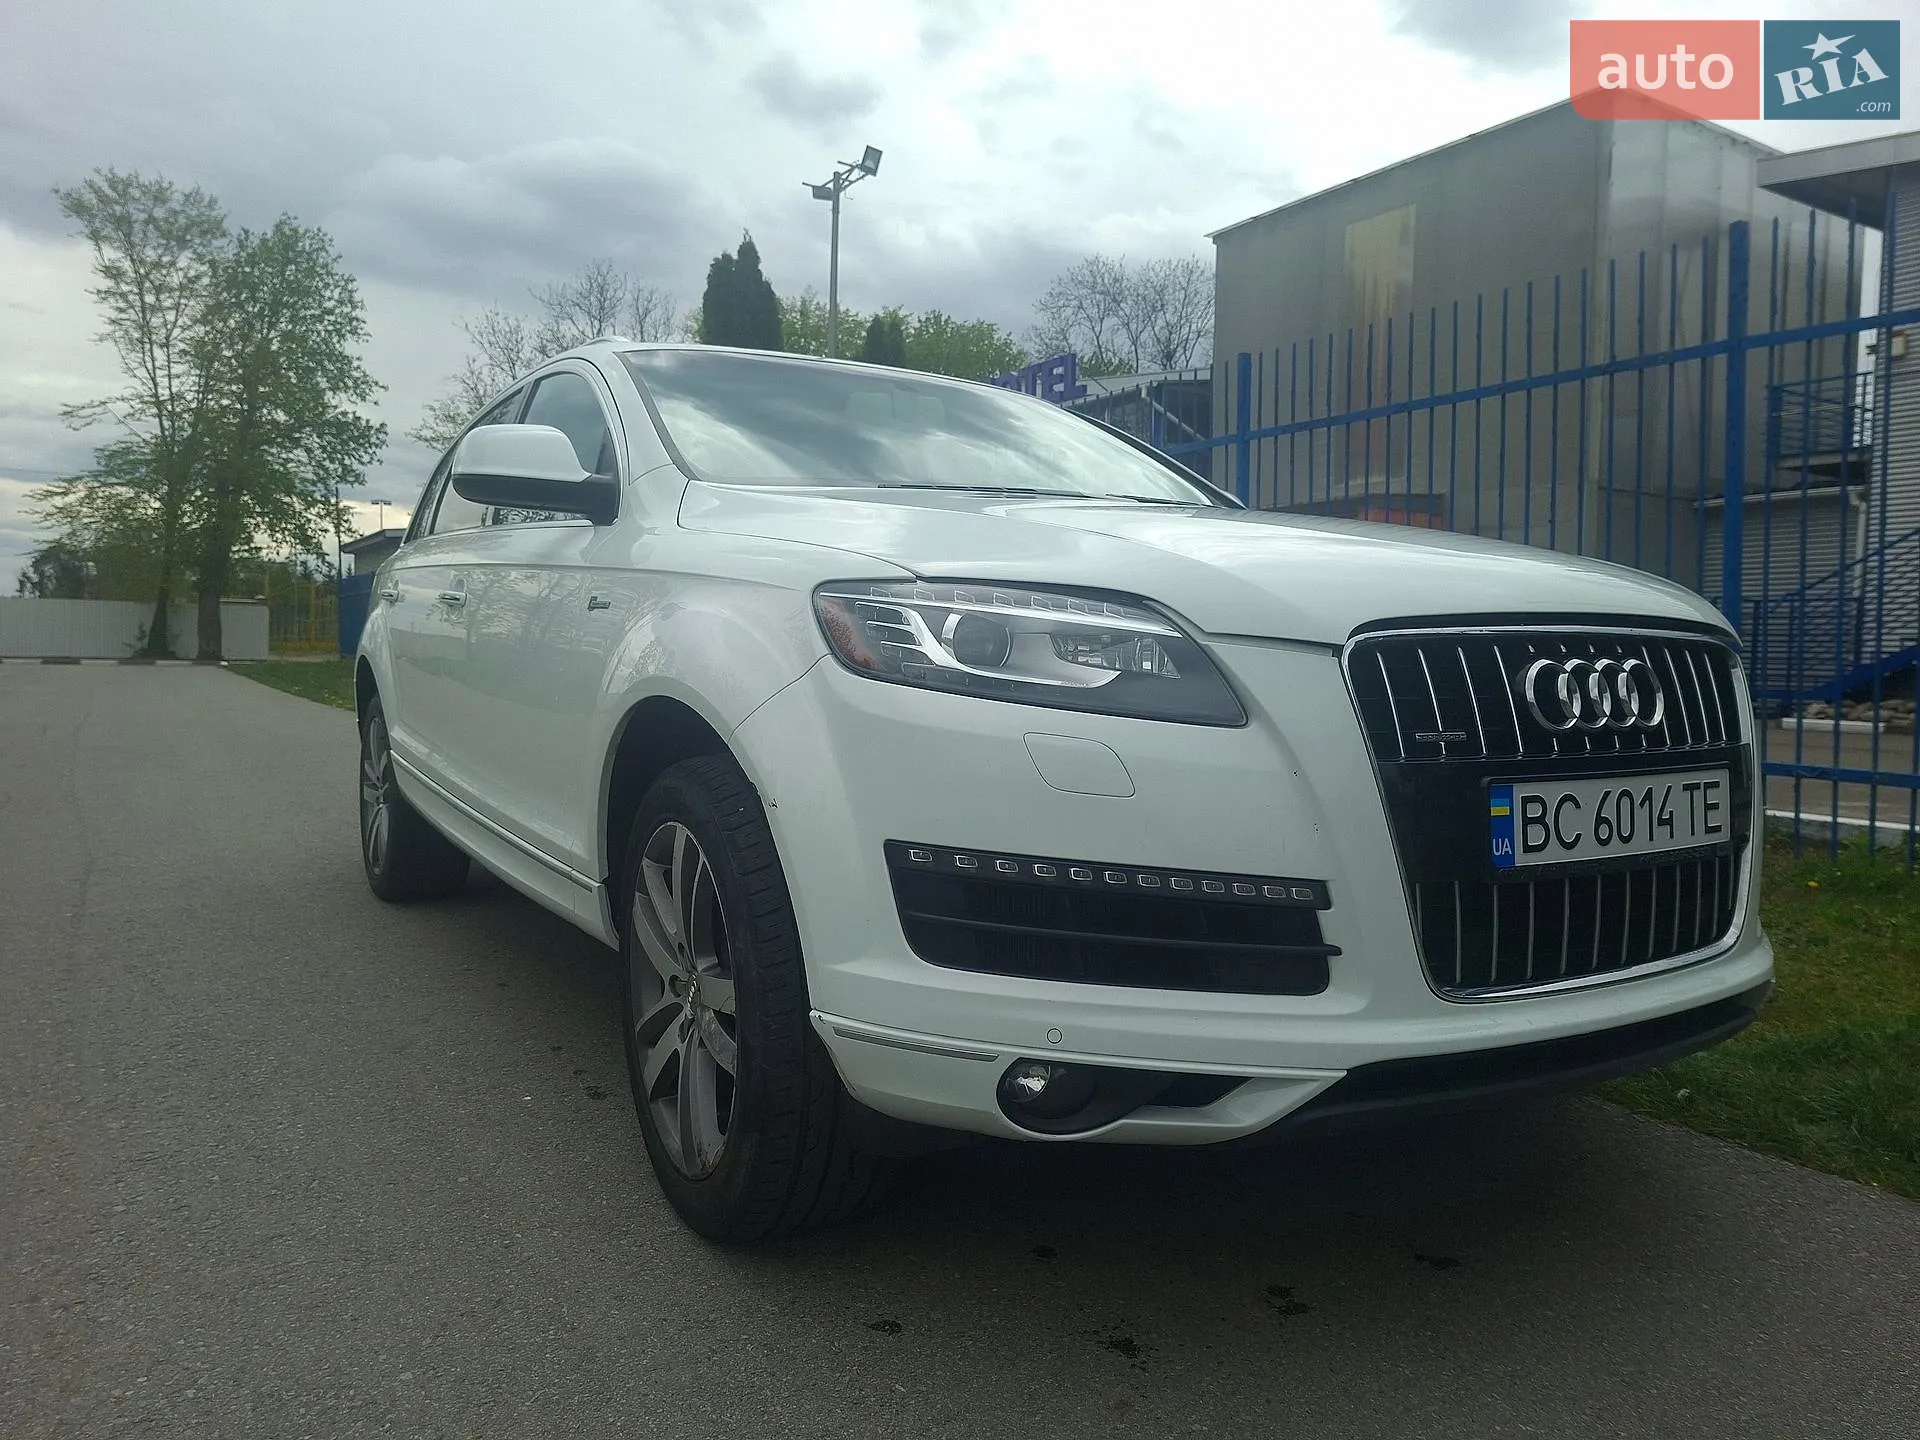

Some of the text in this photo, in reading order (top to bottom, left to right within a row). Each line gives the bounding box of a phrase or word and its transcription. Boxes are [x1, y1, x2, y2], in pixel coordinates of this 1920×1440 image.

[1520, 780, 1722, 854] BC 6014 TE
[1492, 837, 1512, 855] UA
